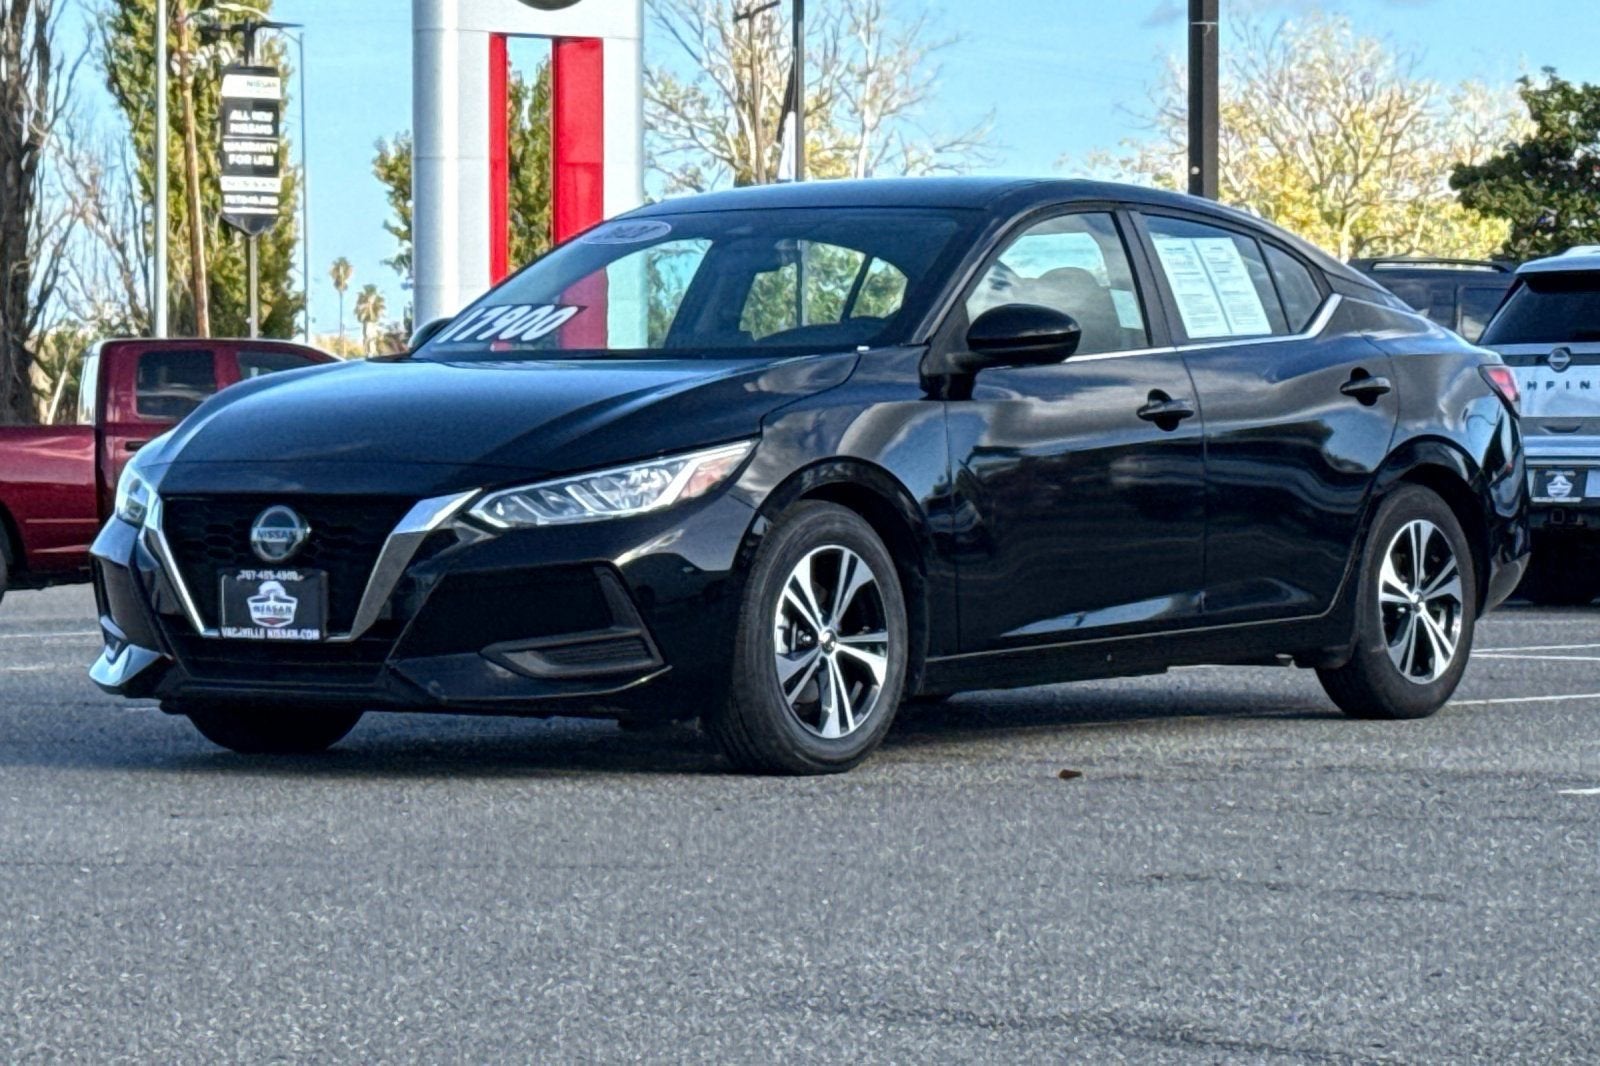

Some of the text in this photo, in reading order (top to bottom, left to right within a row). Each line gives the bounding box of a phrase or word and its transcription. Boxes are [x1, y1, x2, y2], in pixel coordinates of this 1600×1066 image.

[230, 110, 274, 122] ALL NEW
[223, 141, 278, 153] WARRANTY
[228, 153, 275, 166] FOR LIFE
[436, 305, 580, 345] 17900
[257, 529, 297, 541] NISSAN
